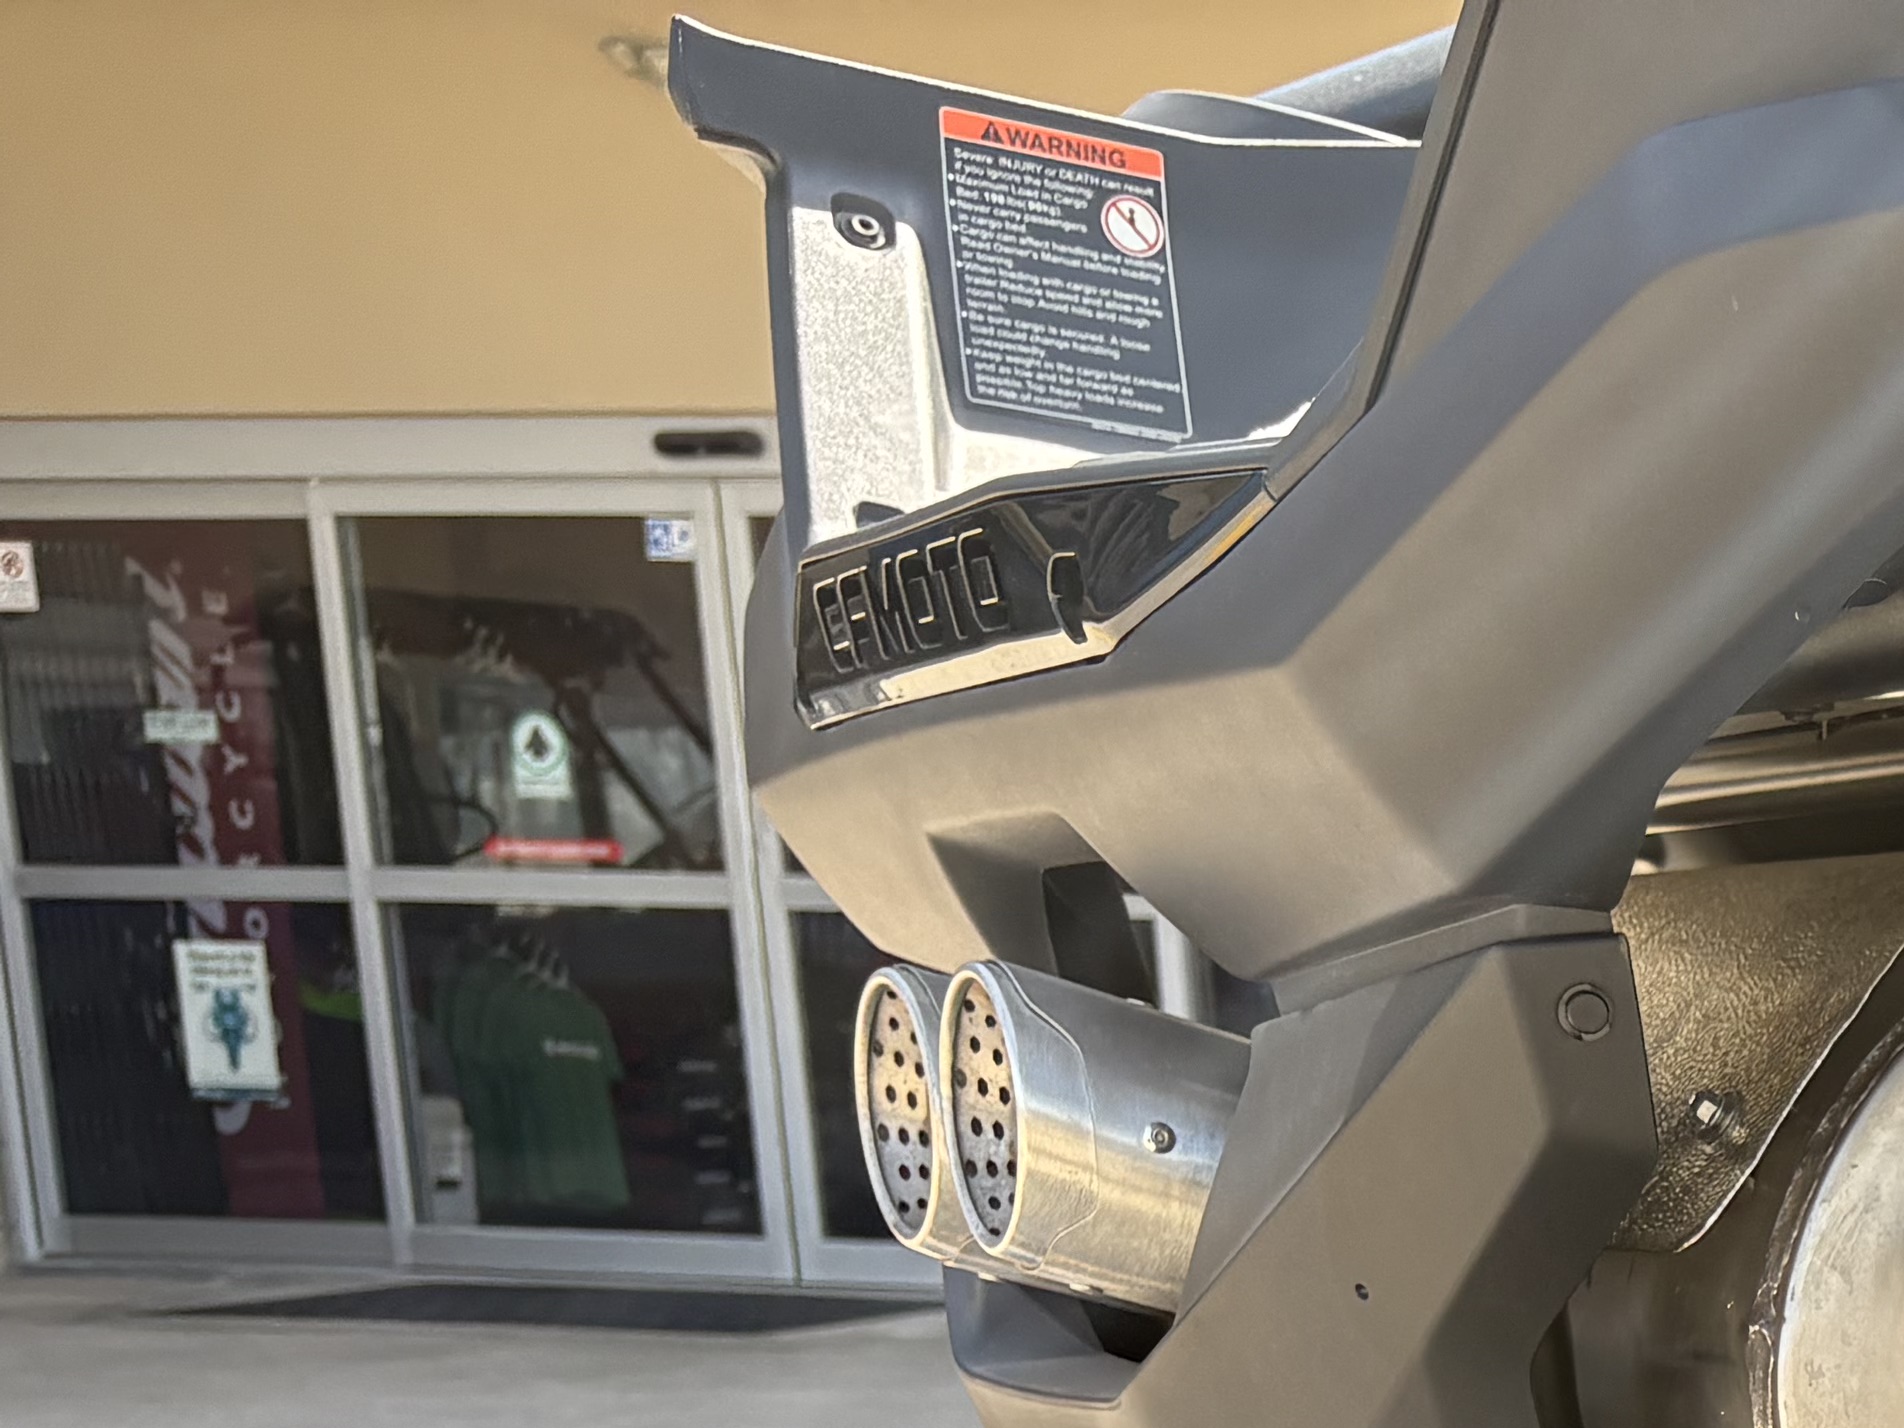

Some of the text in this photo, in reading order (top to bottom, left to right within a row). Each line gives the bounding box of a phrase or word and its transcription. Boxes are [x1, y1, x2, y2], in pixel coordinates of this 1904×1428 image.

[953, 146, 993, 166] Severe
[997, 155, 1043, 176] INJURY
[1058, 167, 1099, 187] DEATH
[1100, 175, 1120, 191] can
[1006, 126, 1126, 168] WARNING
